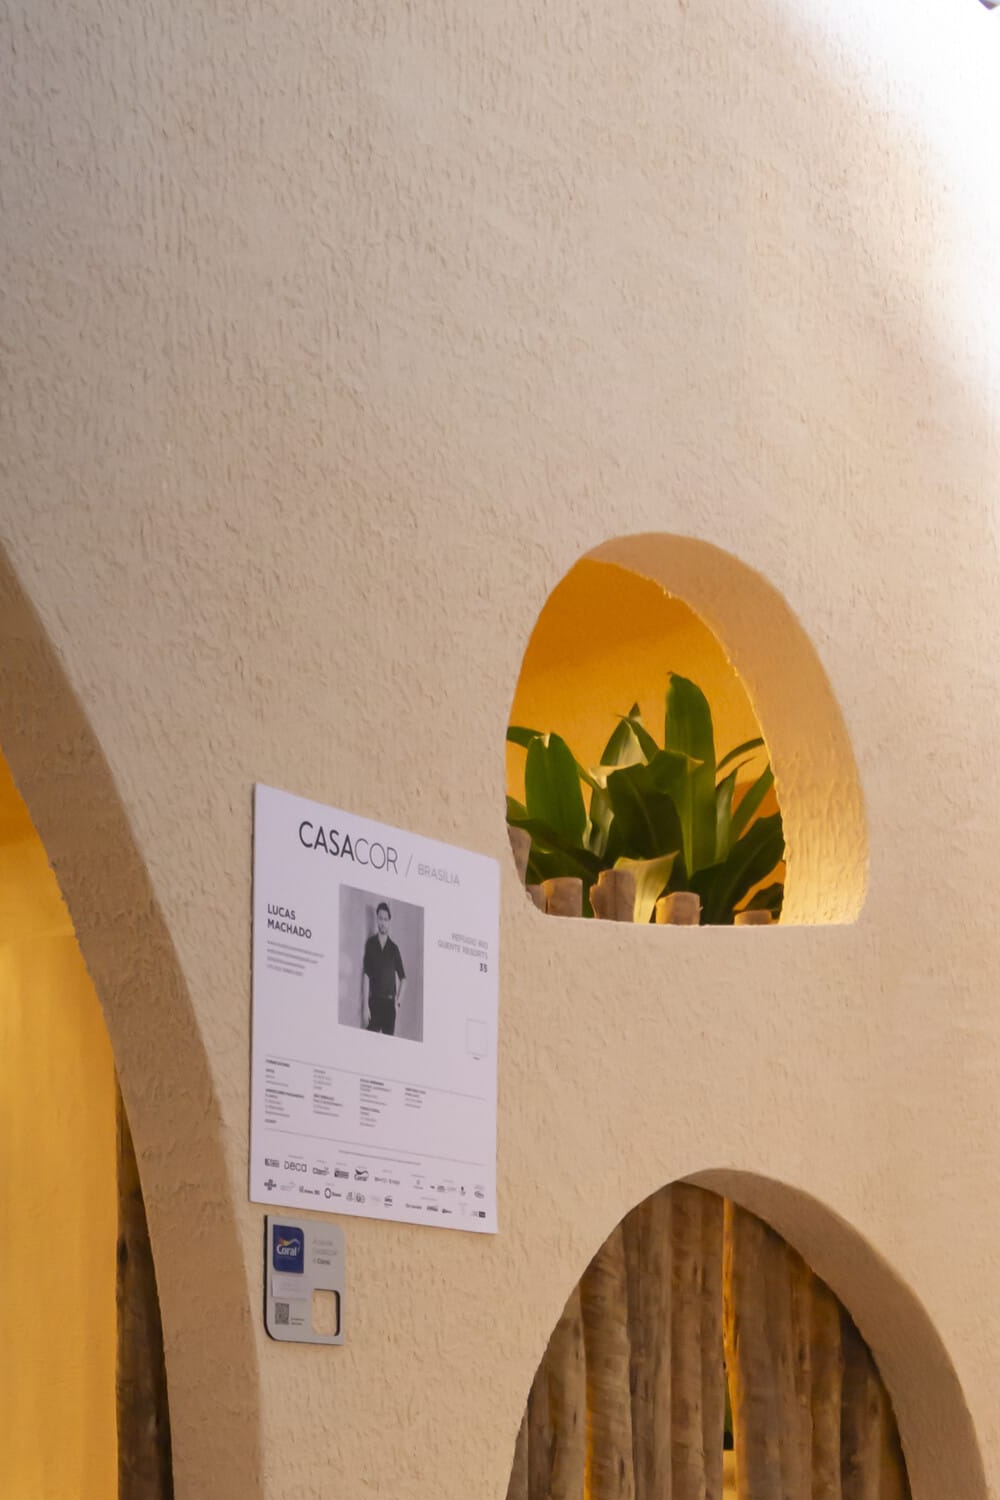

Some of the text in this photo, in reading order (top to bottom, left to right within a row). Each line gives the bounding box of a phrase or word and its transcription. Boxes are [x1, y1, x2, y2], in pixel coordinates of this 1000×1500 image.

[299, 821, 399, 875] CASACOR
[267, 904, 296, 920] LUCAS
[267, 918, 312, 939] MACHADO
[276, 1244, 297, 1256] Coral
